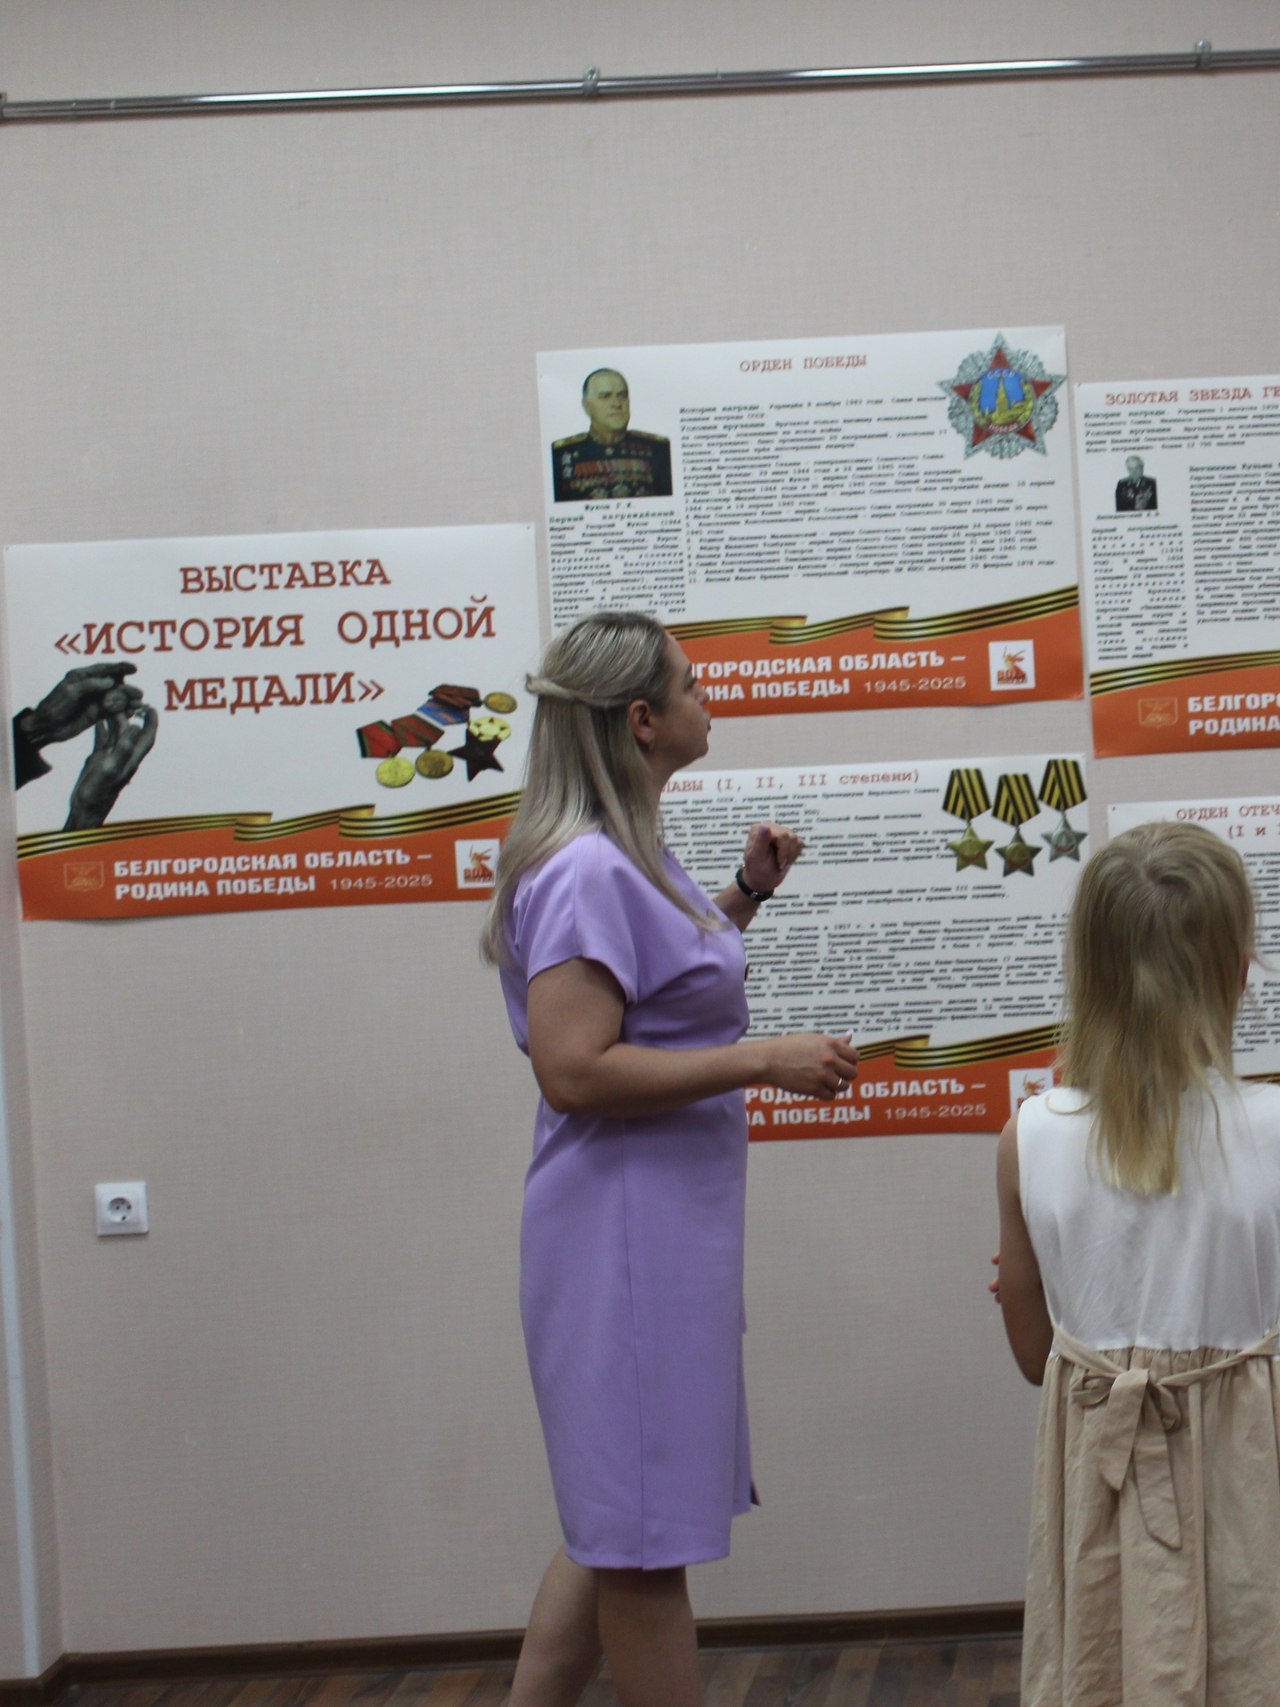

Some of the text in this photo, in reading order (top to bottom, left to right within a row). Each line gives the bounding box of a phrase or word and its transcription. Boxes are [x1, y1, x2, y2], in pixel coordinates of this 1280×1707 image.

[740, 355, 867, 373] ОРДЕН ПОБЕДЫ
[1106, 391, 1179, 406] ЗОЛОТАЯ
[1190, 387, 1252, 401] ЗВЕЗДА
[180, 559, 391, 594] ВЫСТАВКА
[55, 596, 496, 655] «ИСТОРИЯ ОДНОЙ
[692, 656, 832, 679] ГОРОДСКАЯ
[839, 651, 944, 671] ОБЛАСТЬ
[165, 672, 384, 715] МЕДАЛИ»
[705, 676, 966, 701] ИНА ПОБЕДЫ 1945-2025
[1189, 715, 1280, 736] РОДИНА
[799, 774, 828, 787] III
[840, 770, 919, 784] степени)
[1177, 807, 1229, 821] ОРДЕН
[1228, 825, 1244, 839] (I
[1255, 827, 1266, 836] и
[114, 853, 297, 877] БЕЛГОРОДСКАЯ
[305, 849, 411, 868] ОБЛАСТЬ
[115, 874, 432, 900] РОДИНА ПОБЕДЫ 1945-2025
[860, 1079, 965, 1098] ОБЛАСТЬ
[773, 1105, 870, 1124] ПОБЕДЫ
[885, 1104, 986, 1119] 1945-2025
